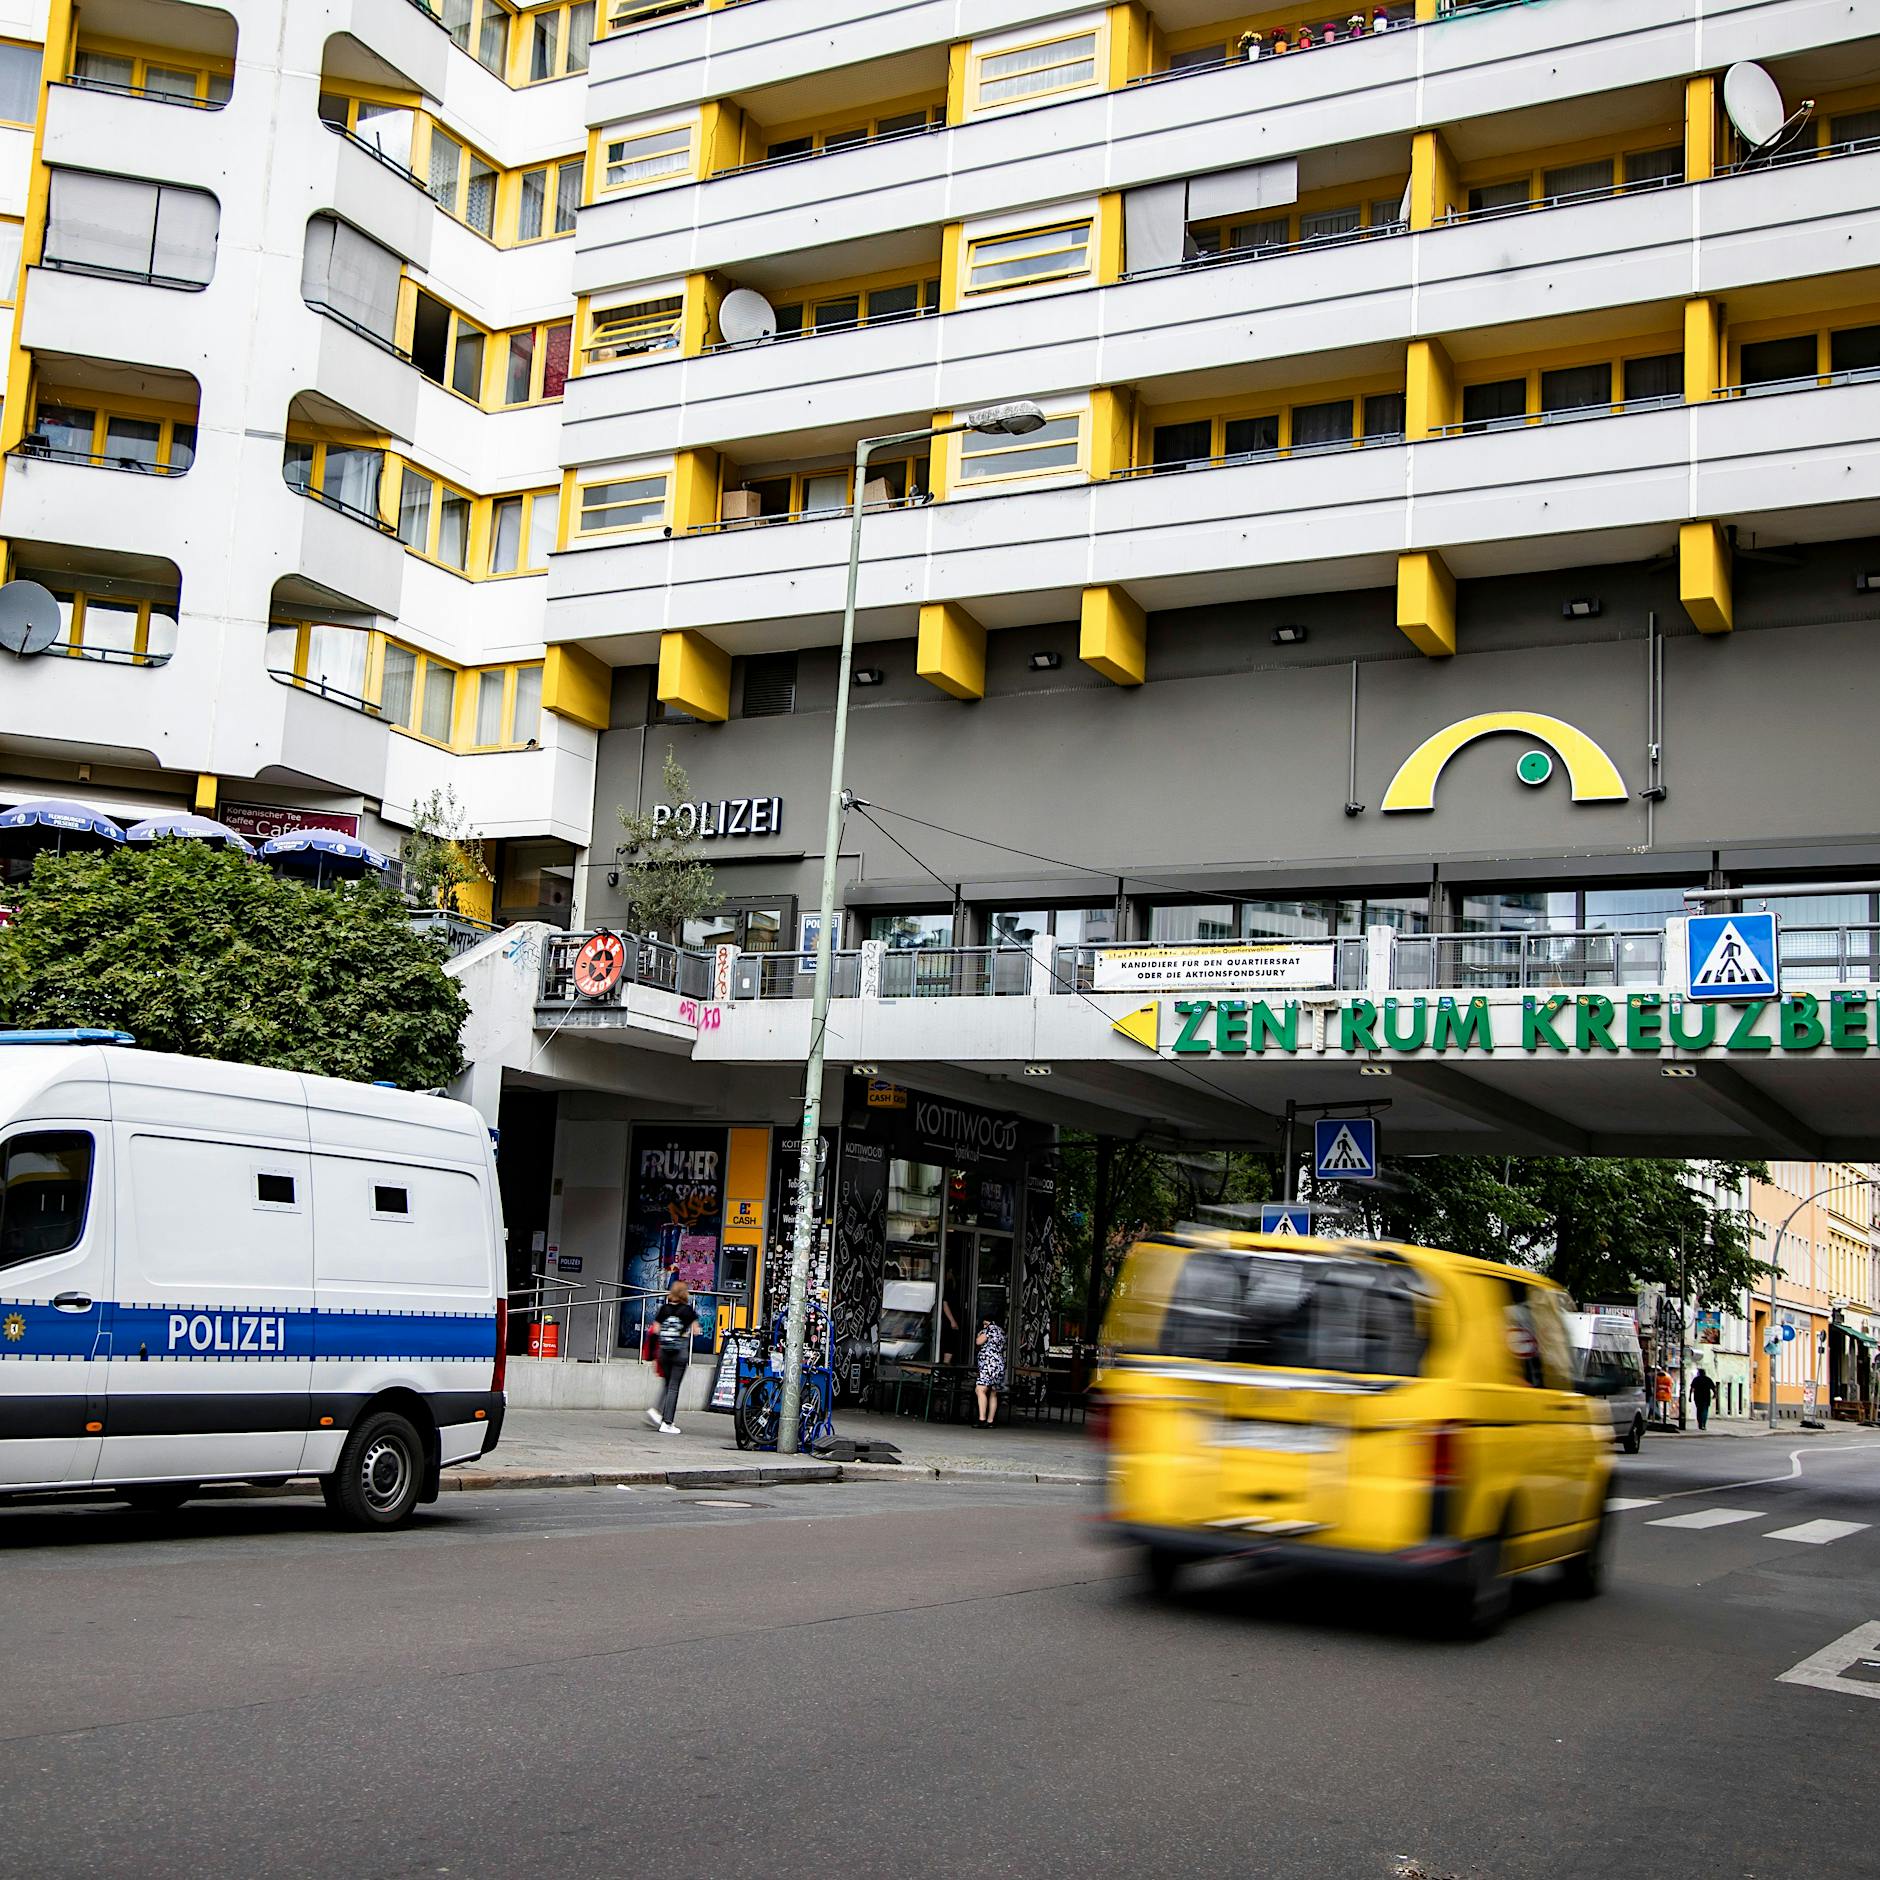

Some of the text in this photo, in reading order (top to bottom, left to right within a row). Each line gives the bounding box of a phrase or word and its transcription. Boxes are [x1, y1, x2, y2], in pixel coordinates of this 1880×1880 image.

[227, 806, 302, 821] Koreanischer Tee
[651, 797, 781, 839] POLIZEI
[226, 815, 254, 826] Kaffee
[806, 919, 837, 928] POLEI
[1121, 961, 1178, 969] KANDIDIERE
[1203, 959, 1223, 967] DEN
[1227, 958, 1300, 966] QUARTIERSRAT
[1185, 969, 1286, 978] AKTIONSFONDSJURY
[1172, 989, 1880, 1053] ZENTRUM KREUZBE
[869, 1094, 892, 1102] CASH
[915, 1100, 1018, 1151] KOTTIWOOD
[640, 1142, 719, 1181] FRÜHER
[732, 1216, 757, 1225] CASH
[560, 1257, 580, 1265] POLIZEI
[168, 1314, 285, 1351] POLIZEI
